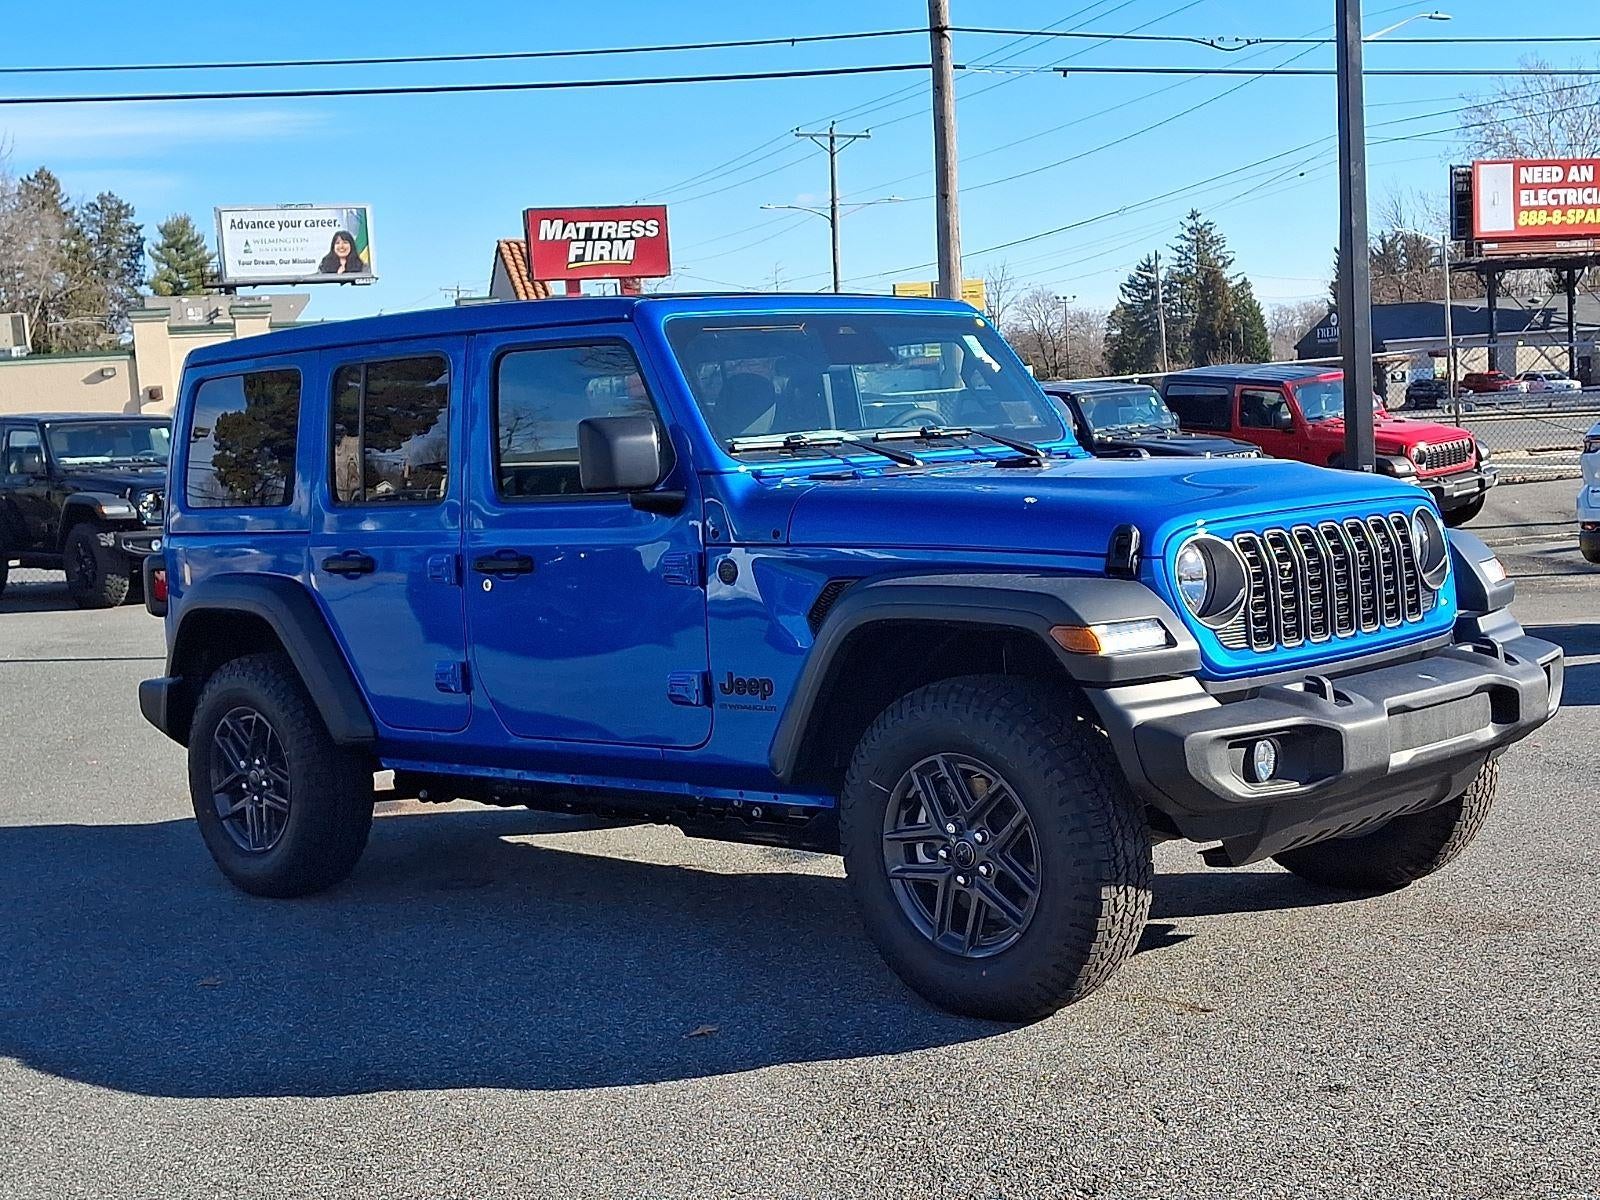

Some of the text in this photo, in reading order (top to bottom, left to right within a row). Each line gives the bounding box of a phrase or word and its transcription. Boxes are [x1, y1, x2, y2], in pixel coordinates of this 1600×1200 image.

[1520, 165, 1594, 184] NEED AN
[1520, 187, 1600, 206] ELECTRICI
[230, 218, 341, 231] Advance your career.
[539, 219, 660, 241] MATTRESS
[252, 237, 309, 245] WILMINGTON
[568, 240, 636, 262] FIRM
[253, 258, 278, 266] Dream,
[292, 257, 316, 265] Mission
[719, 671, 775, 701] Jeep
